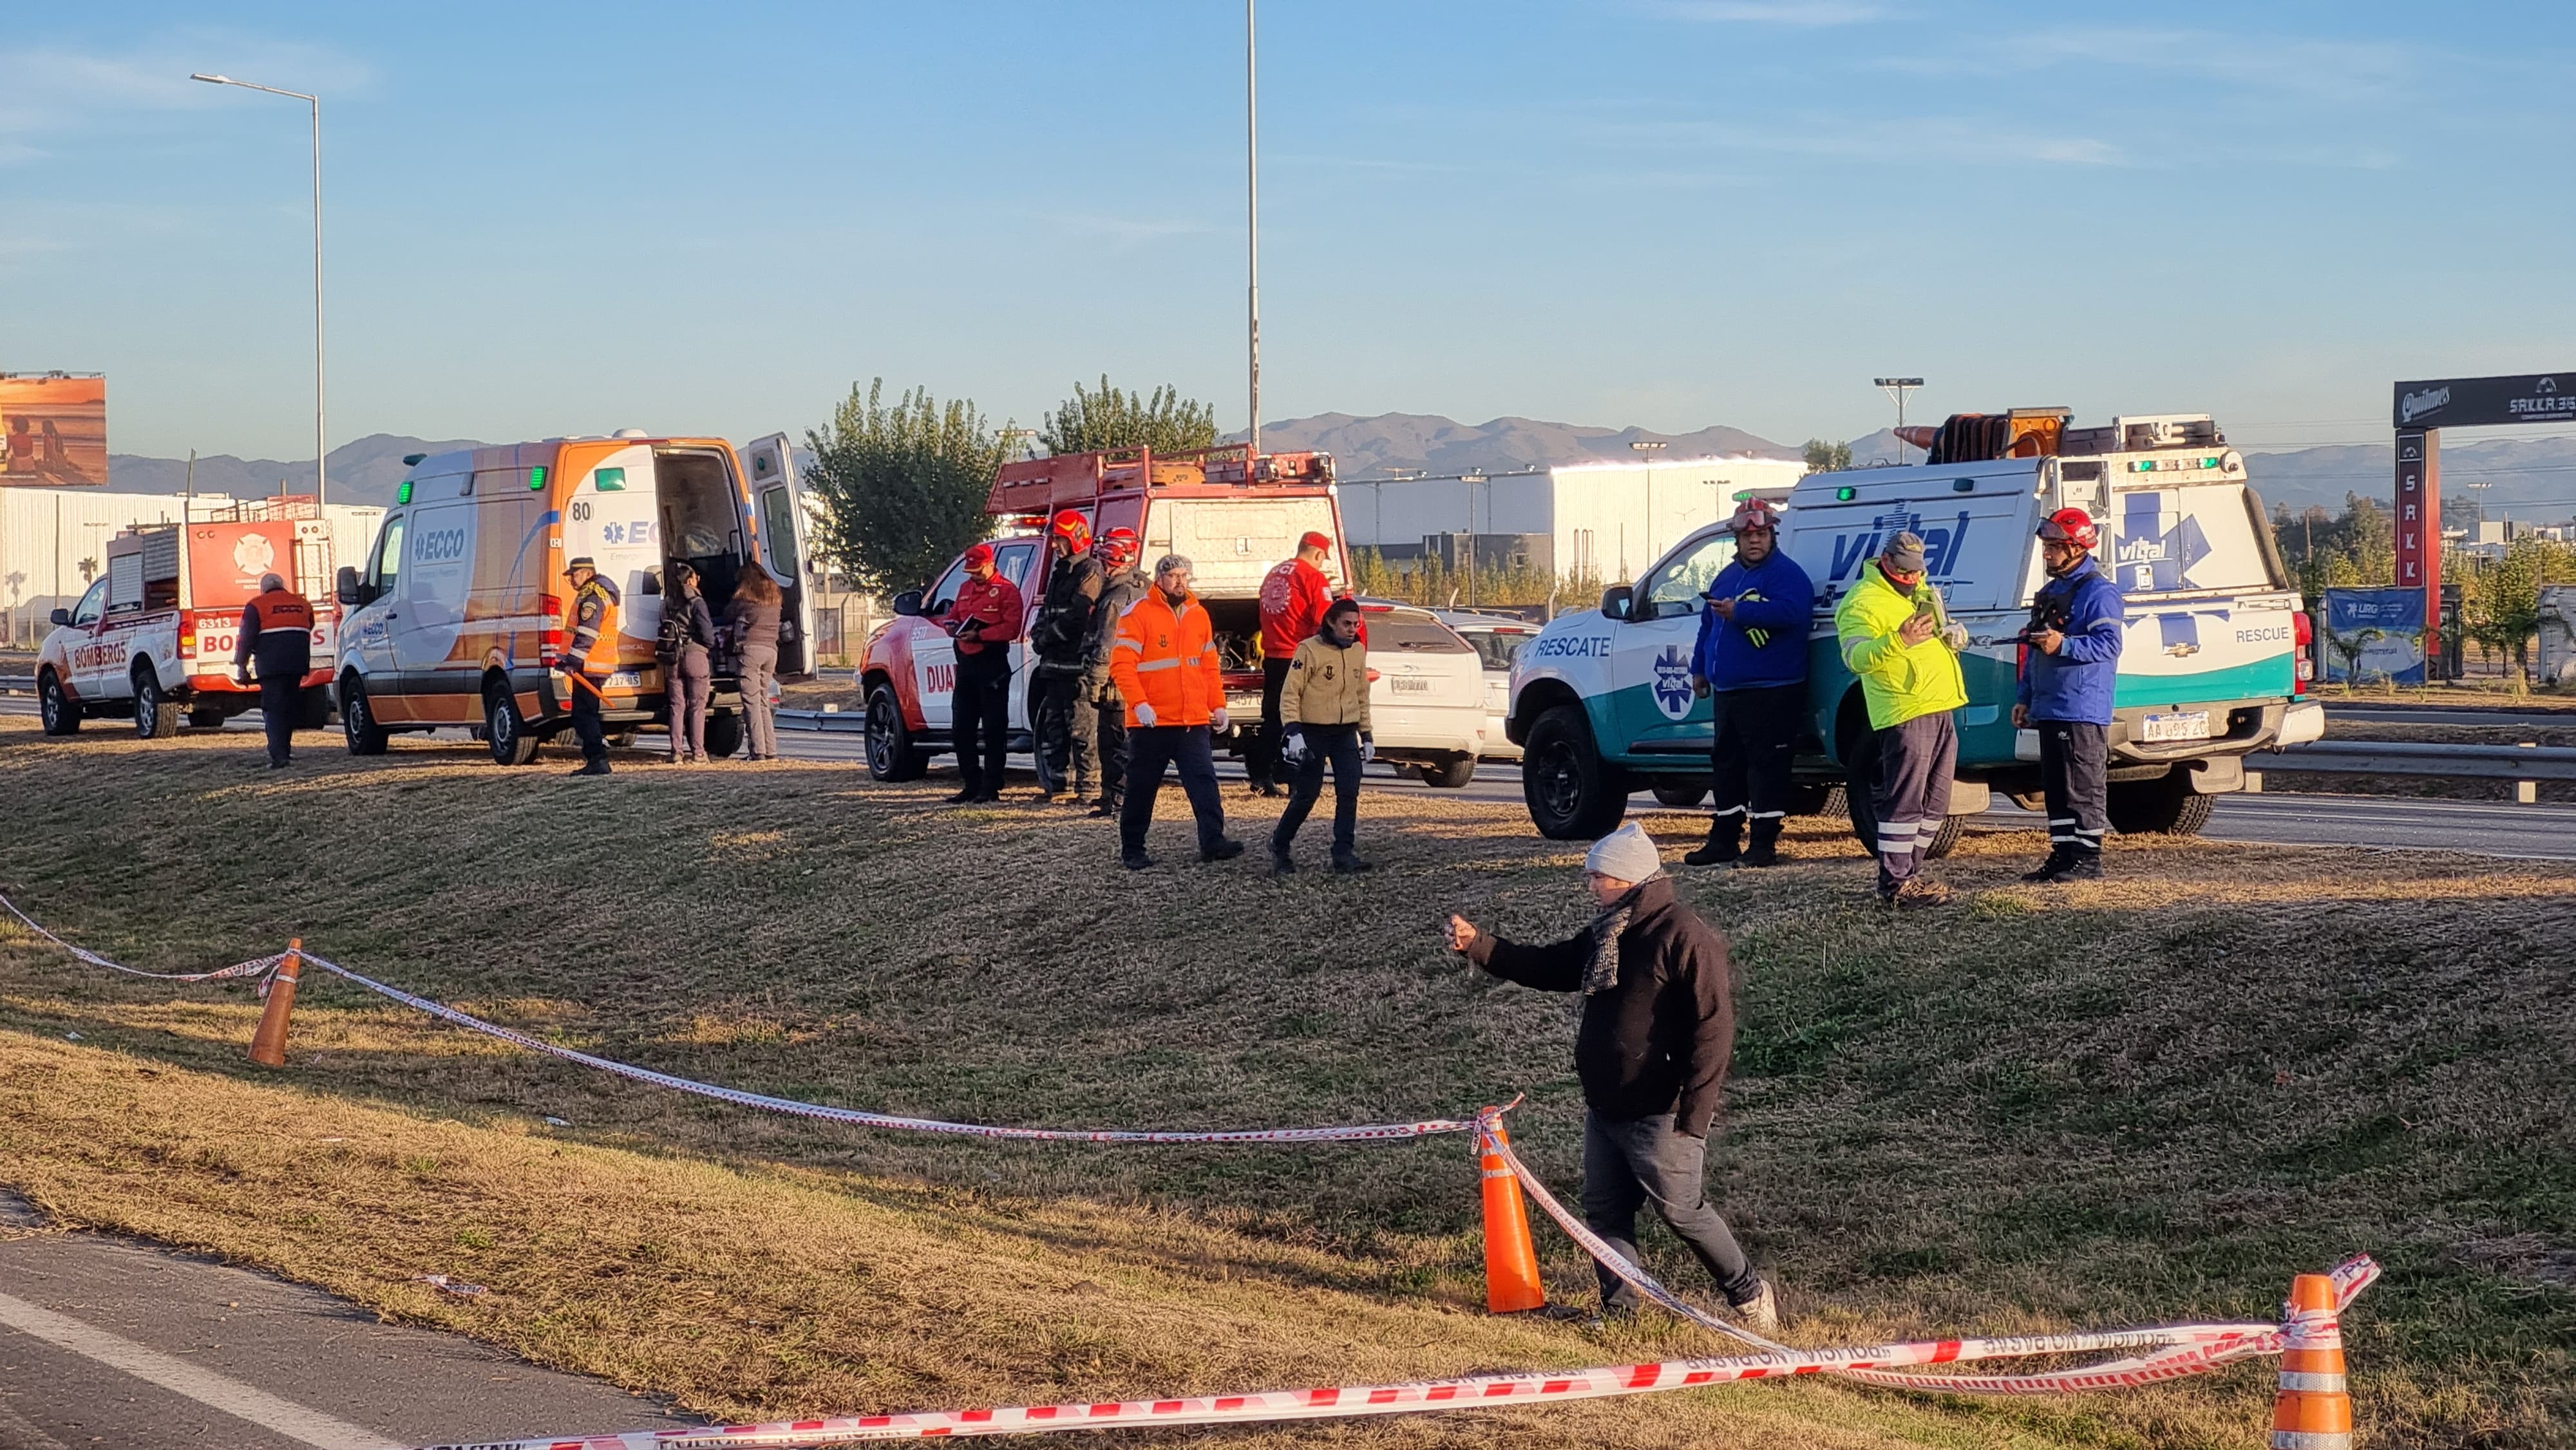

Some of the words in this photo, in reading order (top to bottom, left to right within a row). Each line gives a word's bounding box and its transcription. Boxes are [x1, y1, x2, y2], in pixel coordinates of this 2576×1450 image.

[2402, 386, 2450, 422] Quilmes
[2509, 397, 2555, 413] SAKKA
[573, 502, 591, 521] 80
[424, 528, 464, 560] ECCO
[2358, 603, 2379, 614] URG
[198, 617, 231, 629] 6313
[368, 622, 384, 636] ECCO
[2236, 626, 2289, 643] RESCUE
[74, 641, 126, 669] BOMBEROS
[1535, 637, 1611, 657] RESCATE
[926, 663, 958, 693] DUA
[2148, 723, 2161, 738] AA
